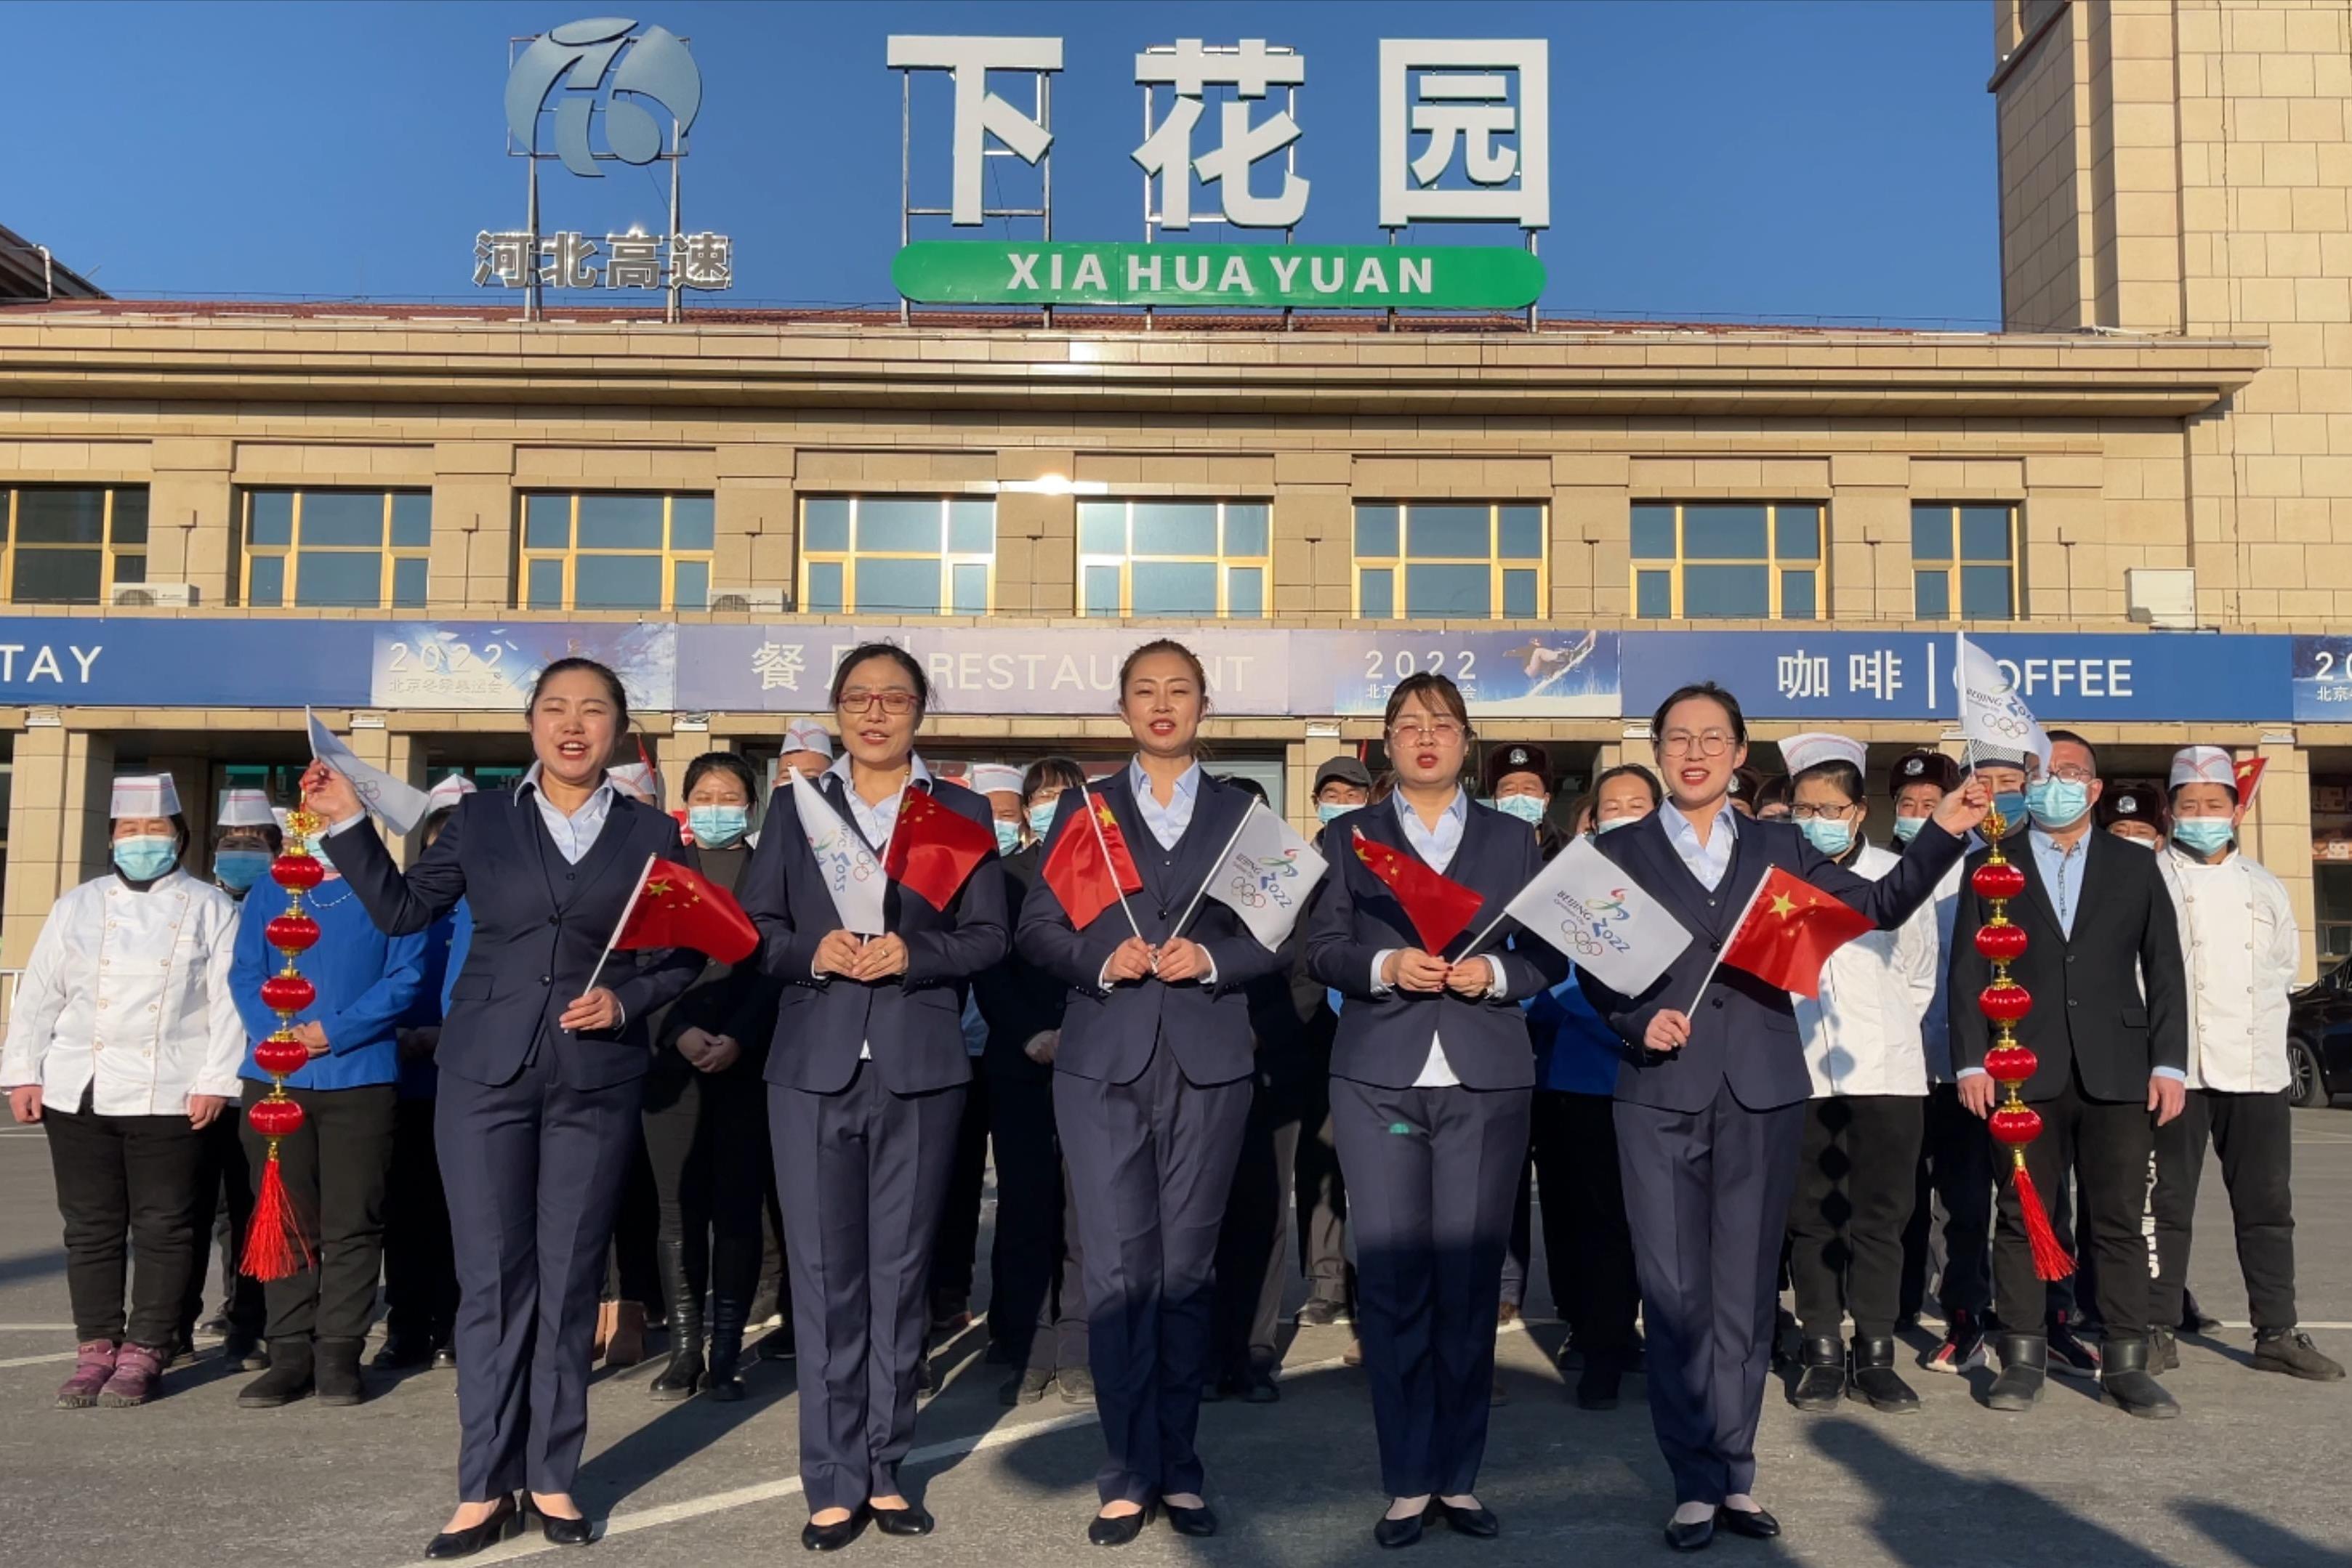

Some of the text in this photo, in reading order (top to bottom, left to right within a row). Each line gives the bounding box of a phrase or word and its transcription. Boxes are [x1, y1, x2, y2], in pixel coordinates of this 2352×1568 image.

[887, 36, 1550, 230] 下花园
[472, 229, 729, 290] 河北高速
[389, 642, 503, 672] 2022
[929, 653, 1254, 692] RESTAUNT
[1365, 650, 1476, 679] 2022
[1777, 650, 1903, 700] 咖啡
[1952, 659, 2132, 697] OFFEE
[2316, 685, 2352, 702] 北京
[1592, 918, 1630, 953] 2022
